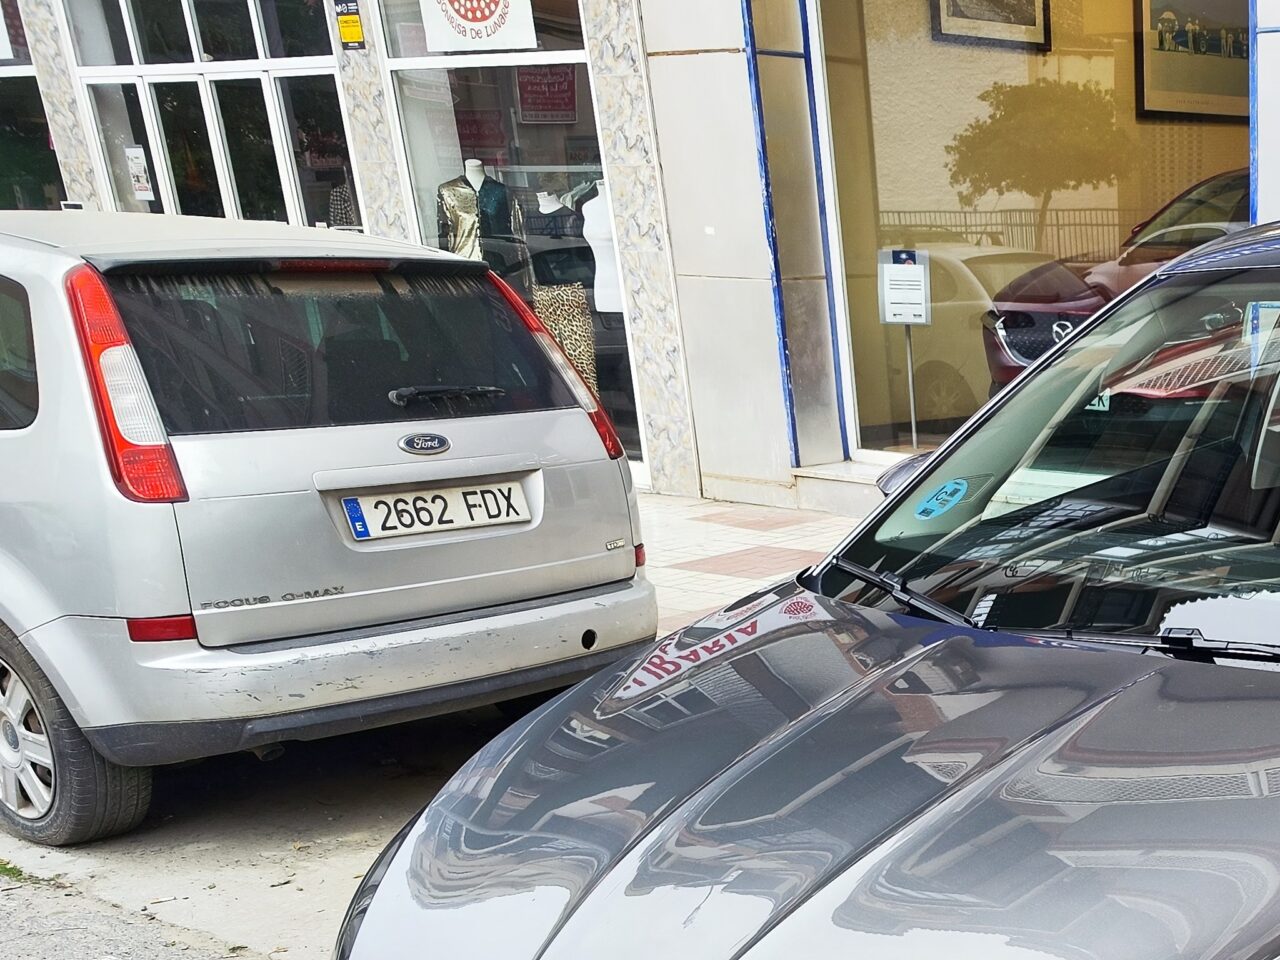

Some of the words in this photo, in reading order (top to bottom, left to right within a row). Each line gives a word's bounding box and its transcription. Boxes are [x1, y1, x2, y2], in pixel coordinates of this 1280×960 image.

[413, 436, 440, 449] Ford
[355, 521, 365, 531] E
[374, 494, 454, 532] 2662
[462, 487, 520, 521] FDX
[200, 595, 271, 610] FOCUS
[281, 585, 345, 601] C-MAX
